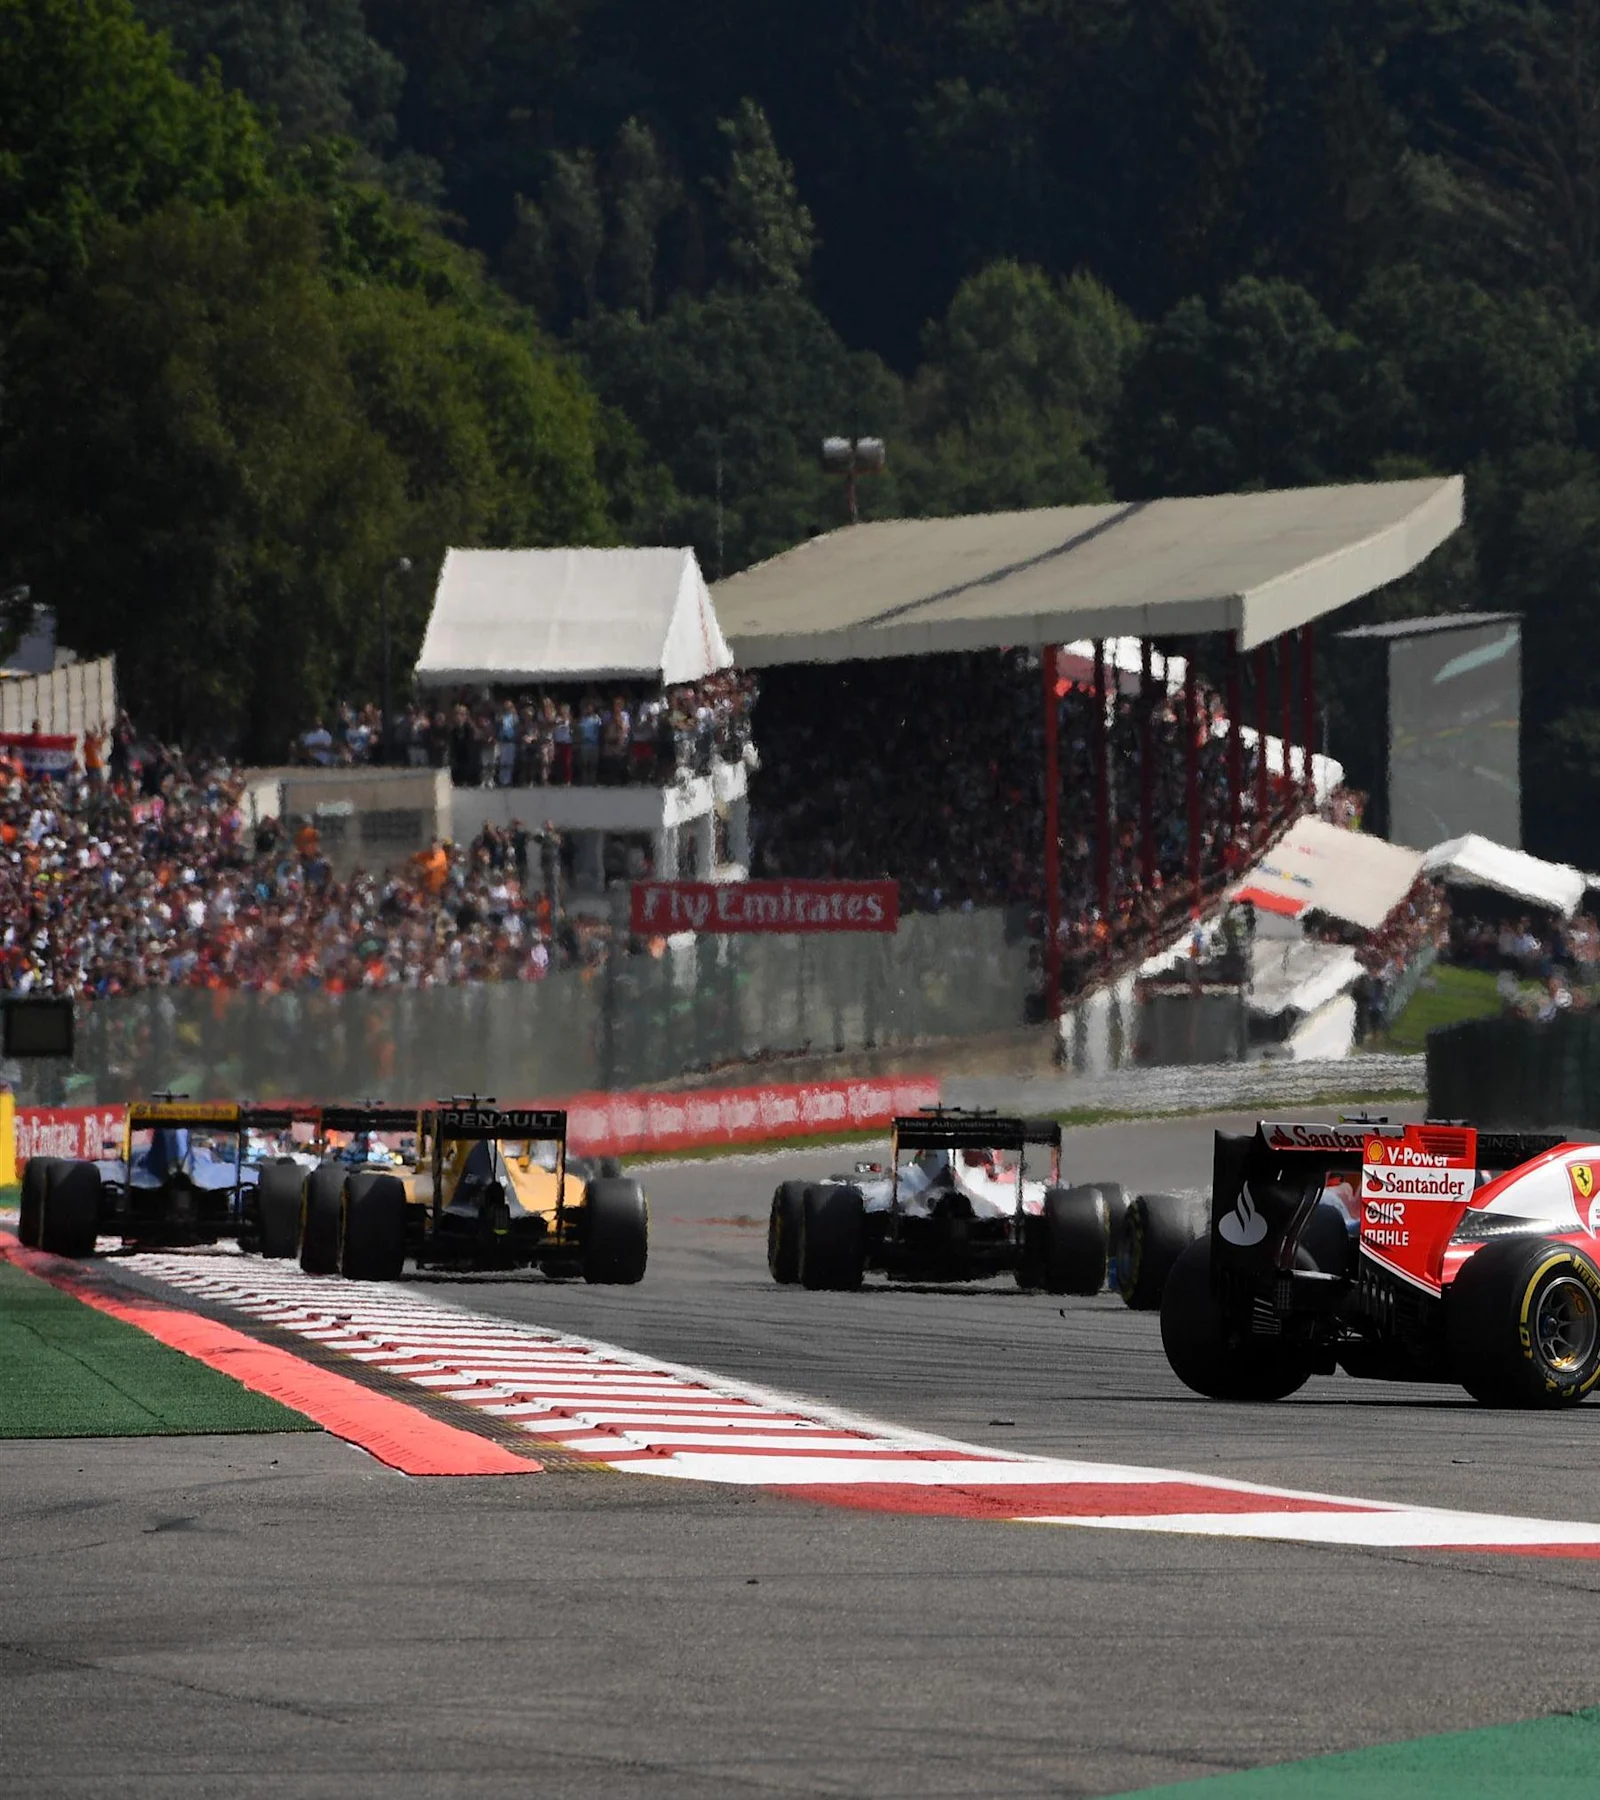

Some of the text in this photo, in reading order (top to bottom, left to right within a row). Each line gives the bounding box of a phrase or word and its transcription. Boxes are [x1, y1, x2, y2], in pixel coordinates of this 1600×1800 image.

[641, 885, 884, 926] Fly Emirates
[445, 1112, 557, 1127] RENAULT
[1387, 1146, 1448, 1167] V-Power
[1385, 1172, 1465, 1196] Santander
[1364, 1229, 1410, 1246] MAHLE
